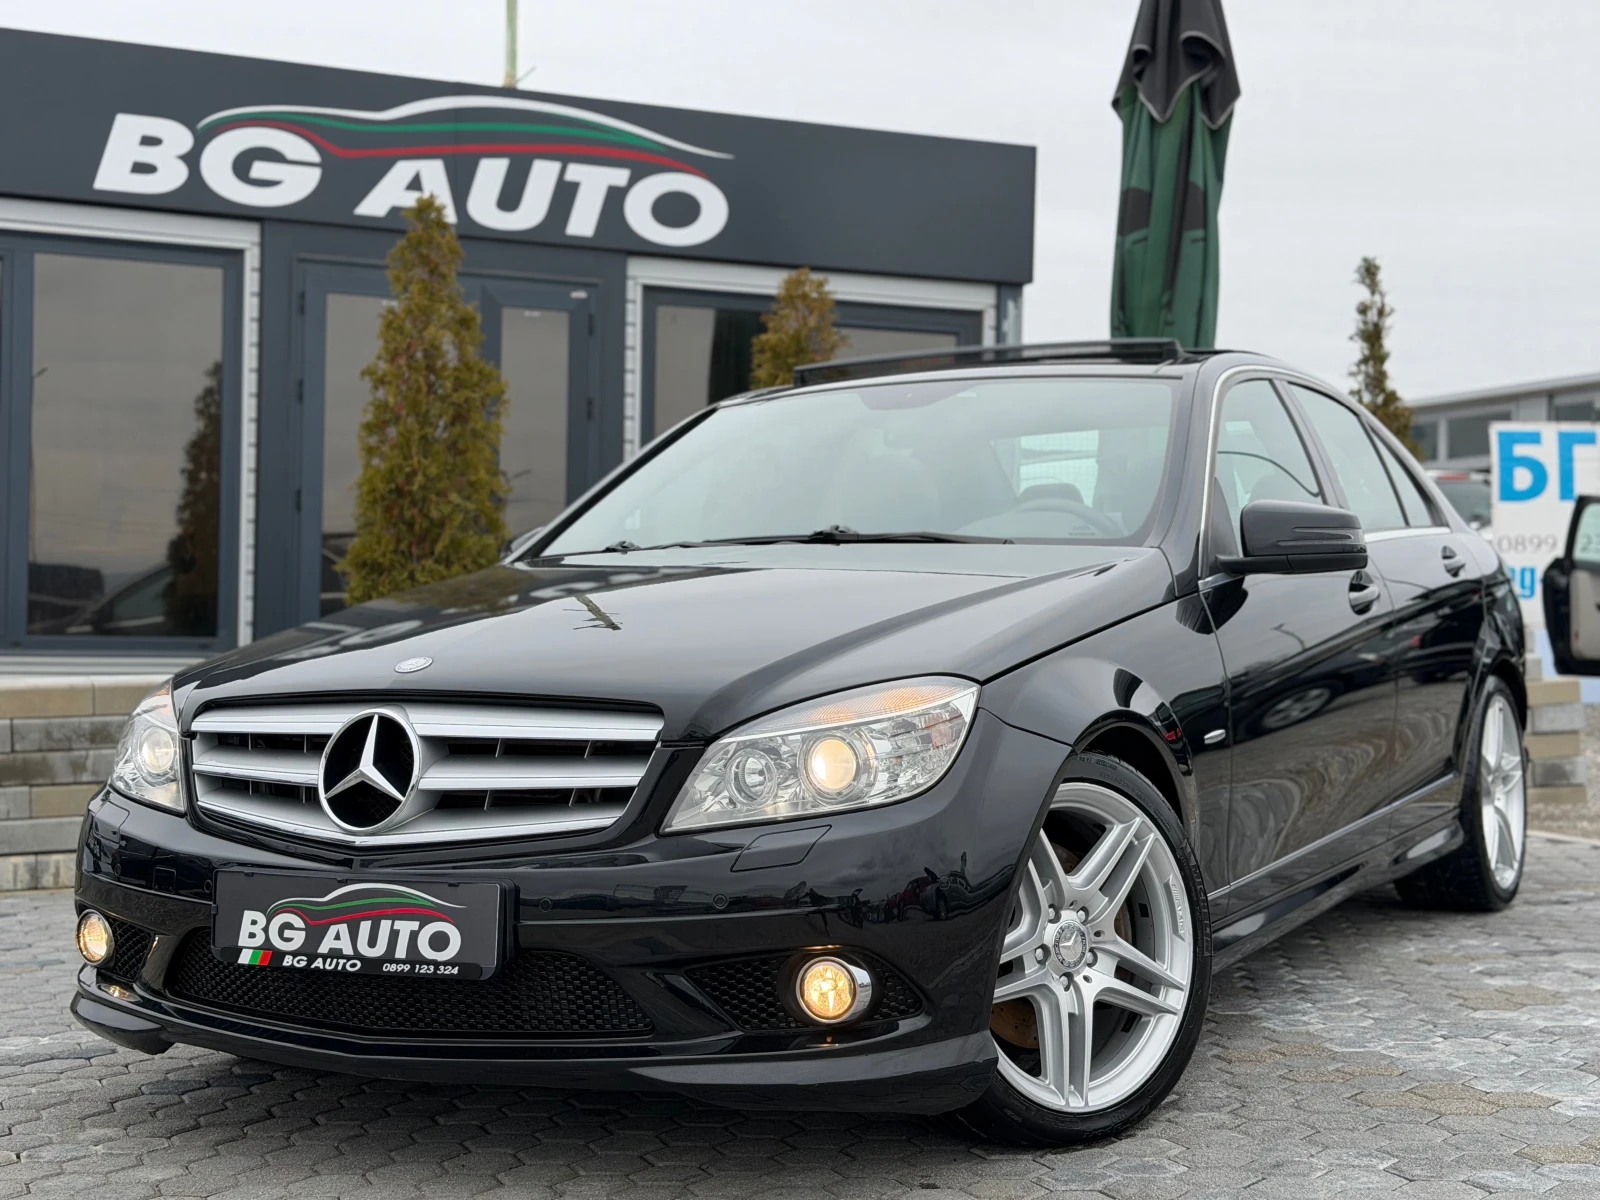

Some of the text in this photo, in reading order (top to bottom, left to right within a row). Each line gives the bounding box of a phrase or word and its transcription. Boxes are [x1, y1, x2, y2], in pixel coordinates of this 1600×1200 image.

[93, 113, 729, 247] BG AUTO
[1498, 431, 1596, 501] БГ
[1499, 534, 1557, 553] 0899
[238, 910, 461, 962] BG AUTO
[282, 955, 361, 971] BG AUTO
[382, 963, 459, 975] 0899 123 324
